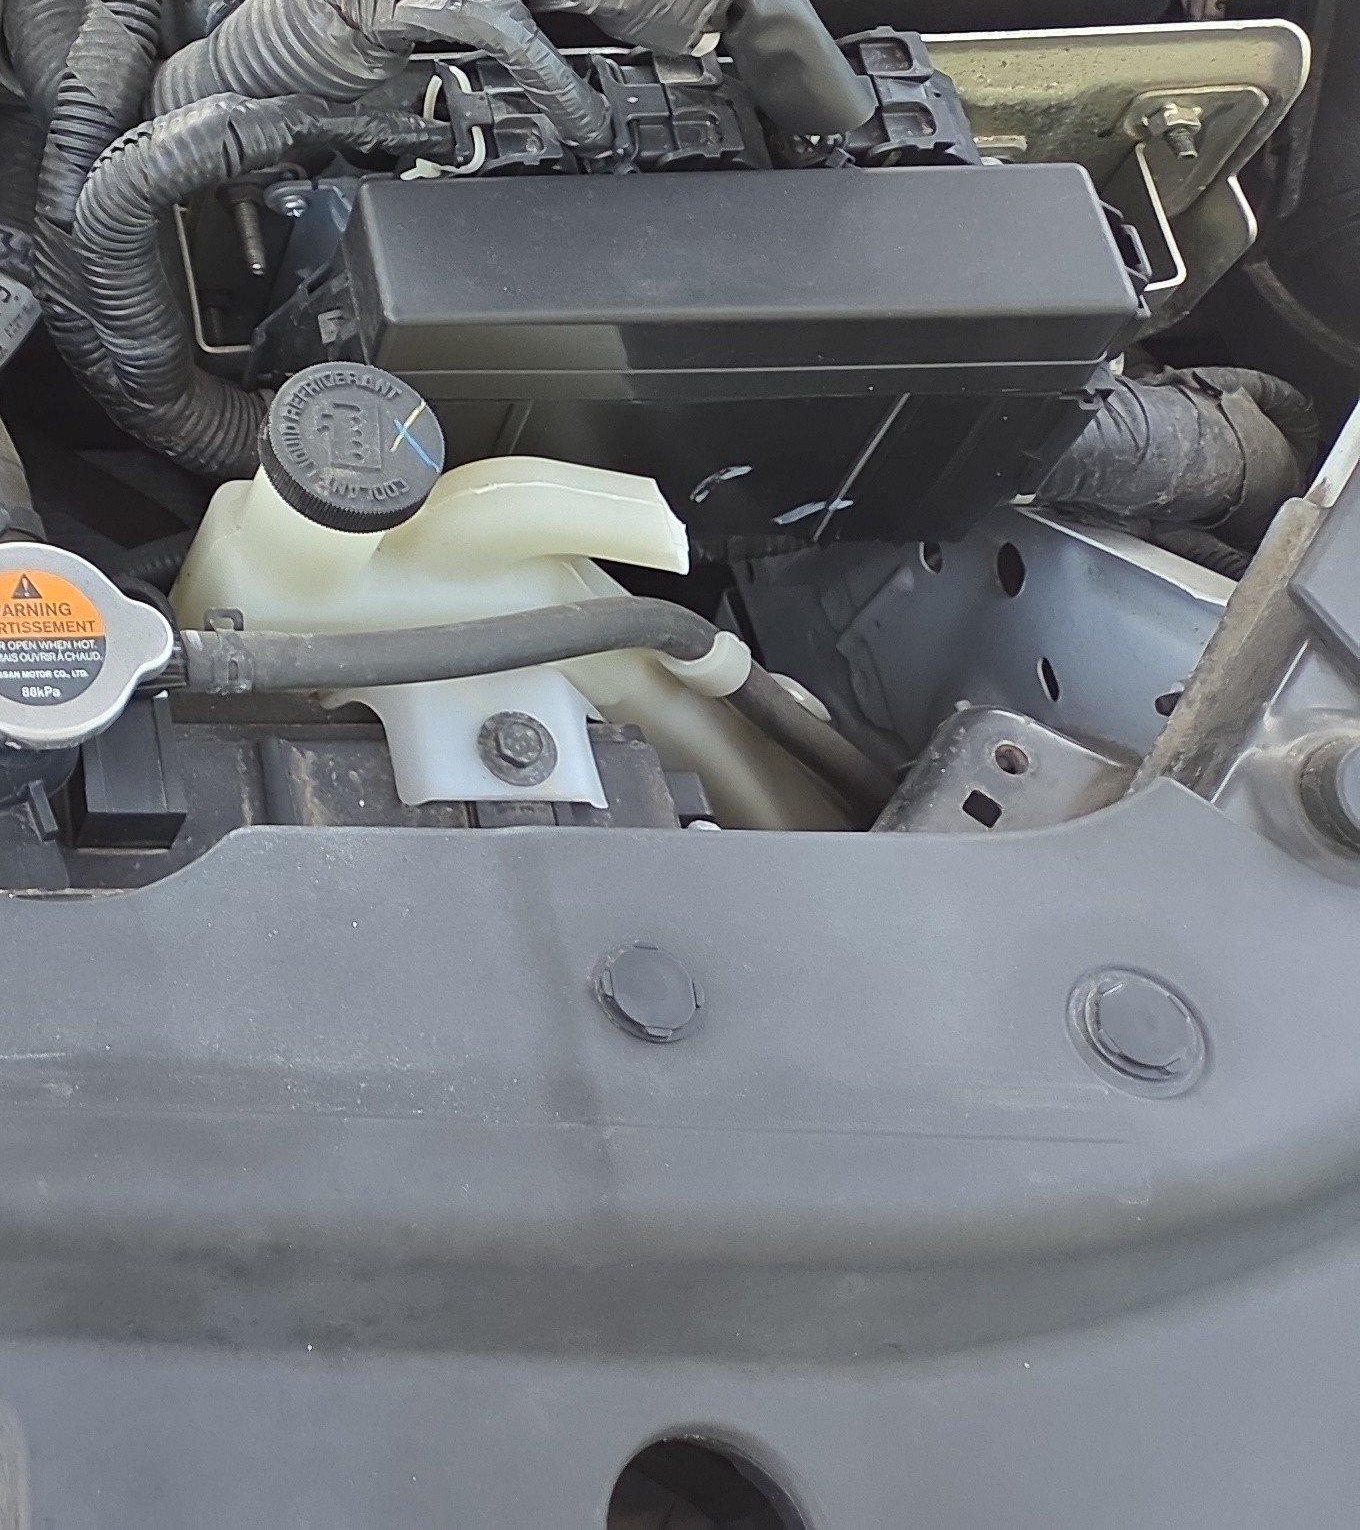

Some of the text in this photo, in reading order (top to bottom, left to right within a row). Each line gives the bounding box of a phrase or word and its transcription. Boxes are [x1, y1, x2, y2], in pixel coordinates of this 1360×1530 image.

[284, 370, 402, 417] REFRIGERANT
[7, 640, 37, 650] OPEN
[38, 640, 72, 650] WHEN
[73, 640, 98, 649] HOT.
[19, 652, 56, 662] OUVRIR
[64, 651, 103, 661] CHAUD.
[21, 670, 53, 679] MOTOR
[21, 686, 61, 698] 88kPa
